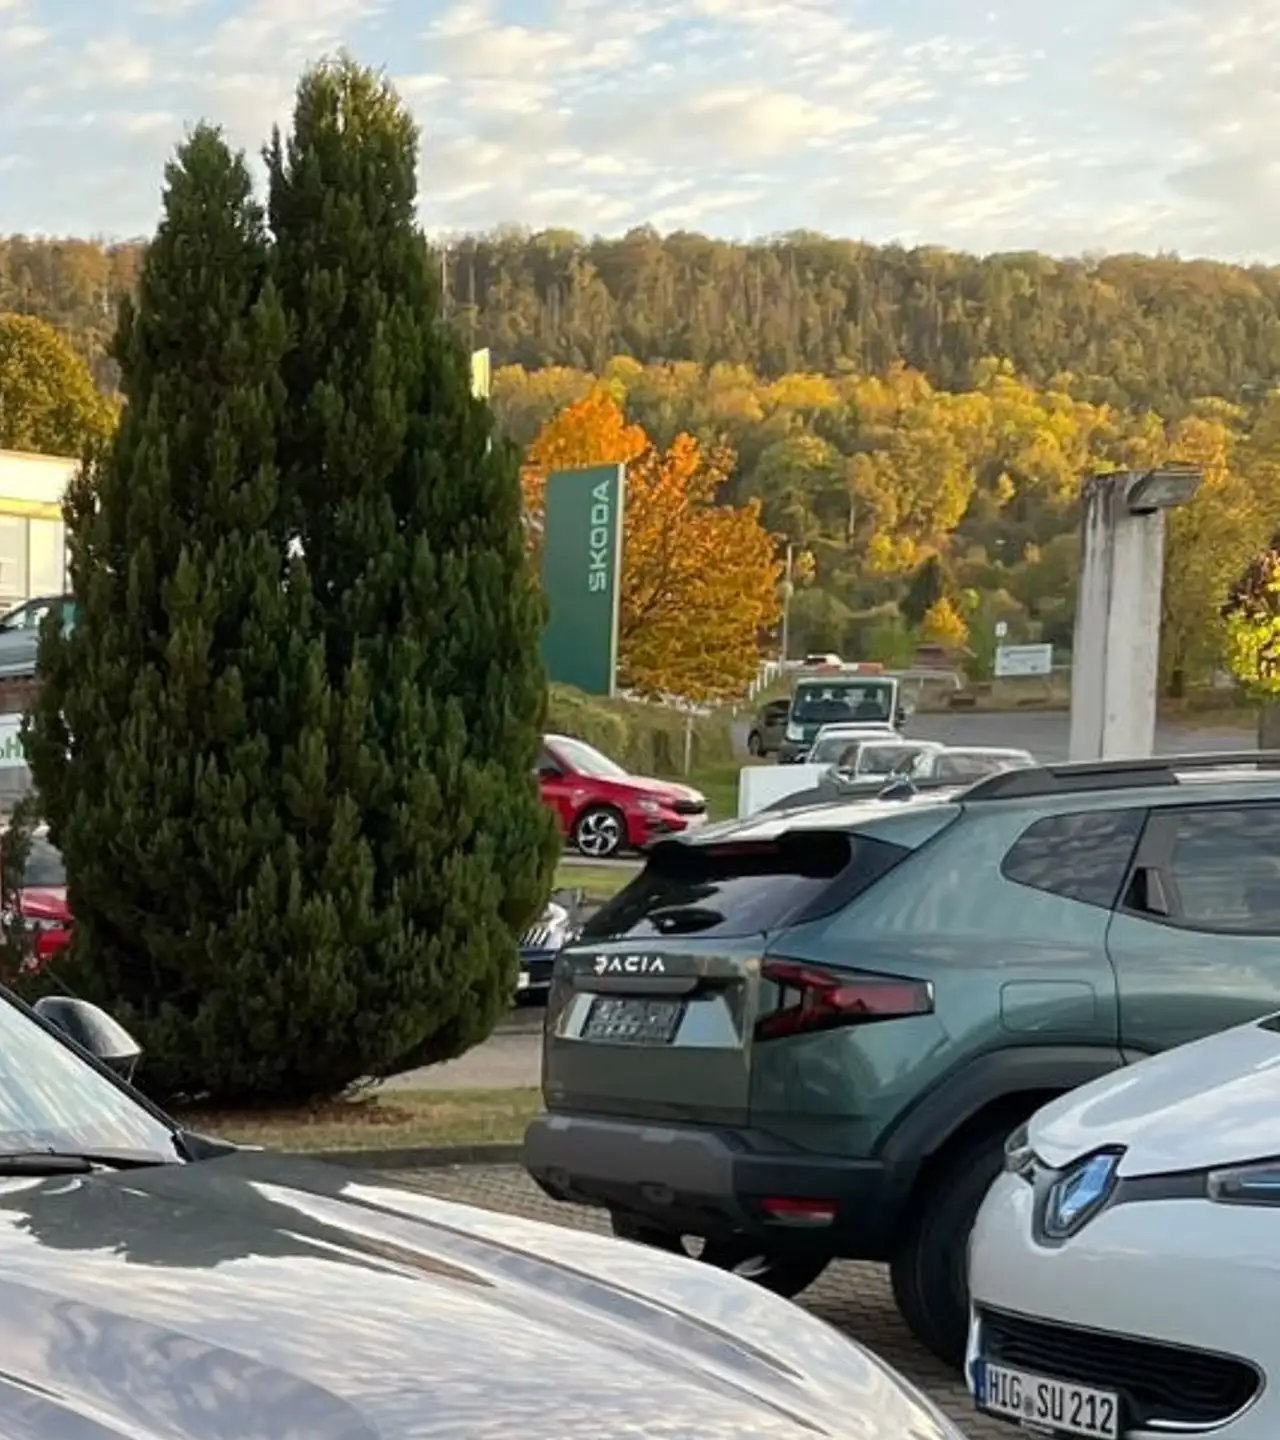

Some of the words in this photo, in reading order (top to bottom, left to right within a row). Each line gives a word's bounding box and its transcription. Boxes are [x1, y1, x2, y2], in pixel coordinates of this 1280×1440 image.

[593, 955, 666, 975] DACIA
[989, 1365, 1022, 1409] HIG
[1036, 1383, 1064, 1422] SU
[1069, 1390, 1114, 1435] 212
